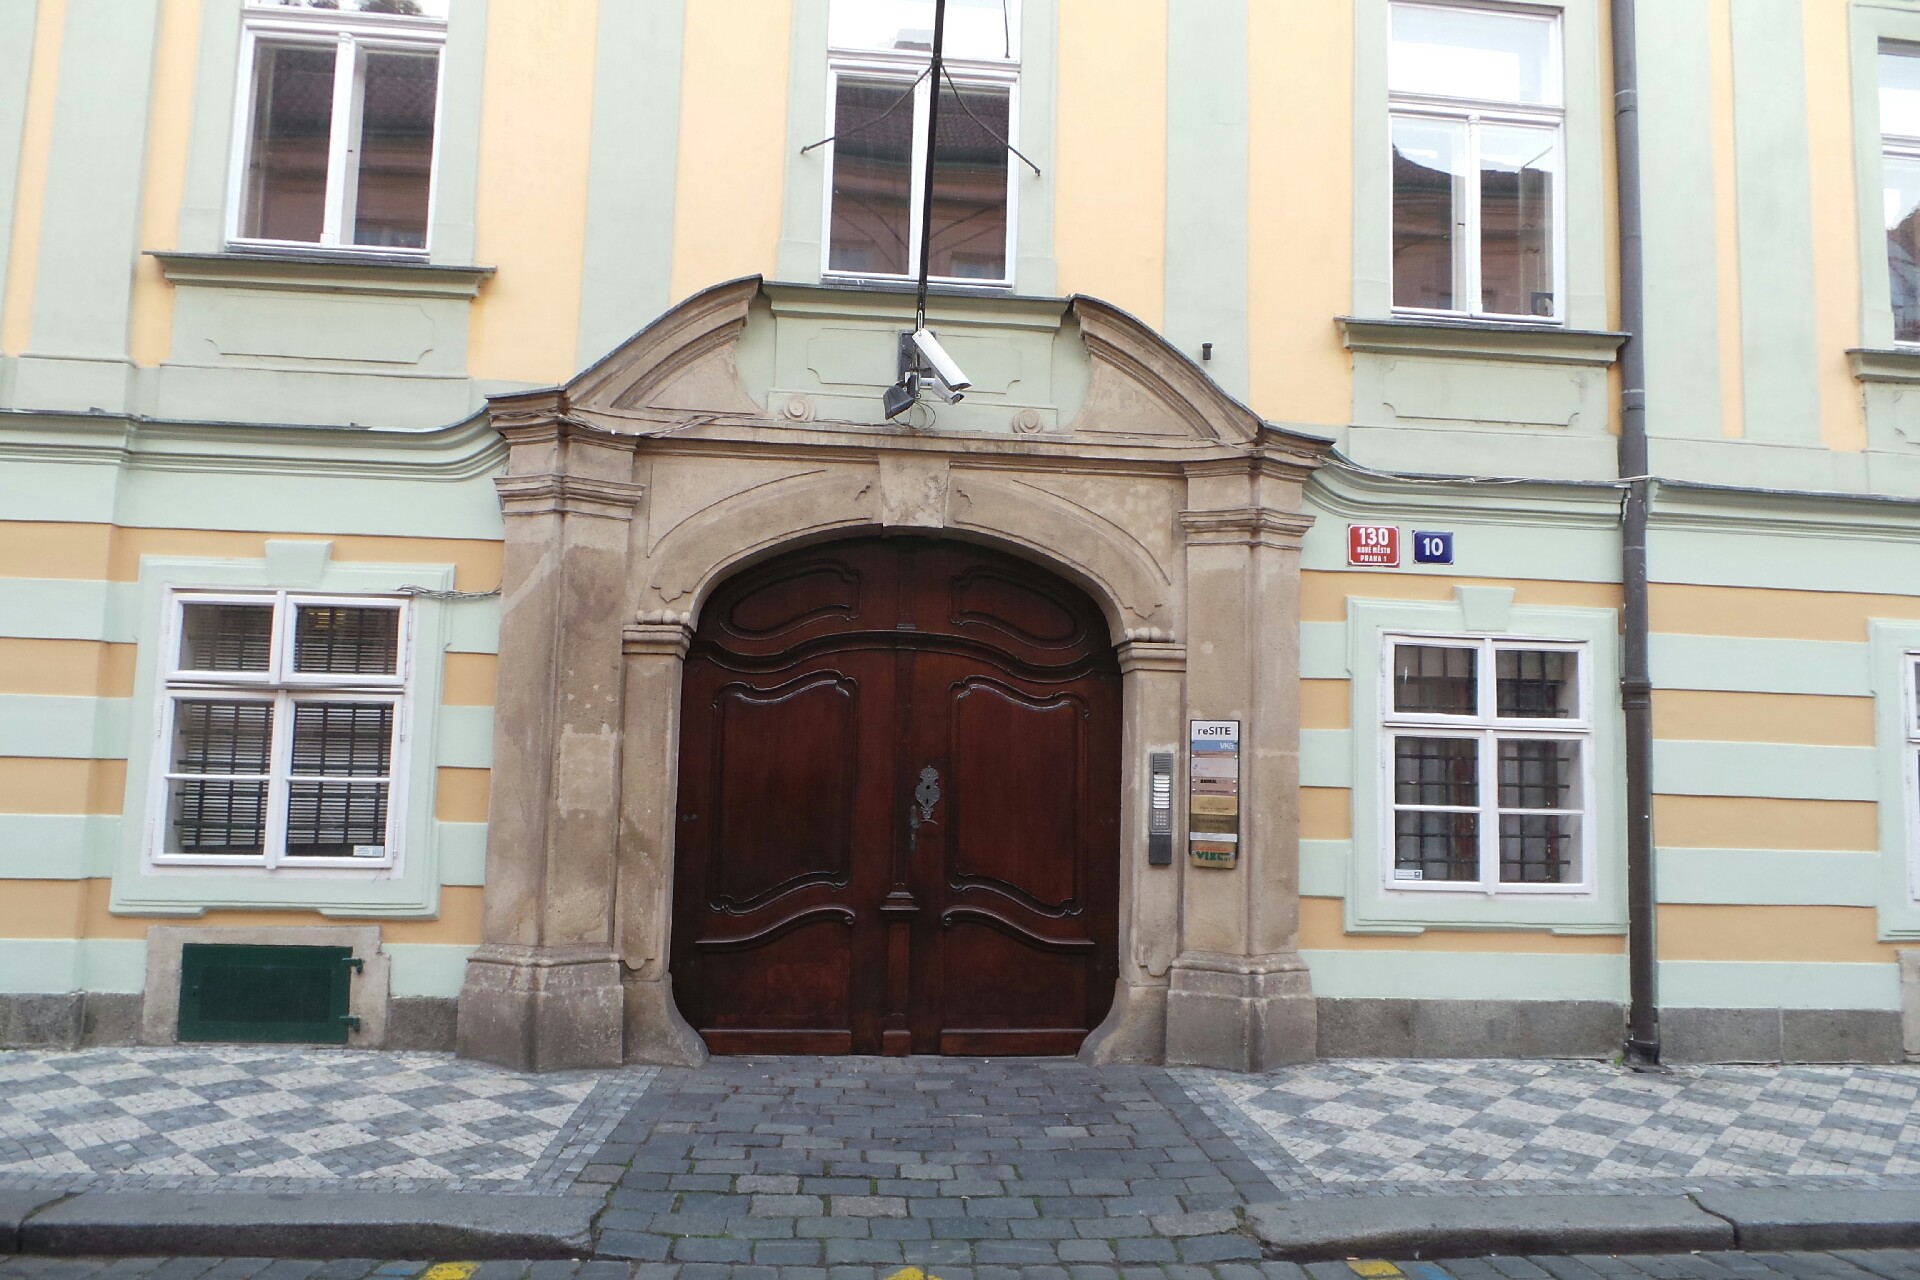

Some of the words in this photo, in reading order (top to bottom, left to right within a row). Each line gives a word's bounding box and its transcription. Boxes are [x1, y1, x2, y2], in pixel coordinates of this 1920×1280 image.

[1359, 528, 1389, 545] 130
[1423, 537, 1444, 556] 10
[1198, 726, 1231, 735] reSITE
